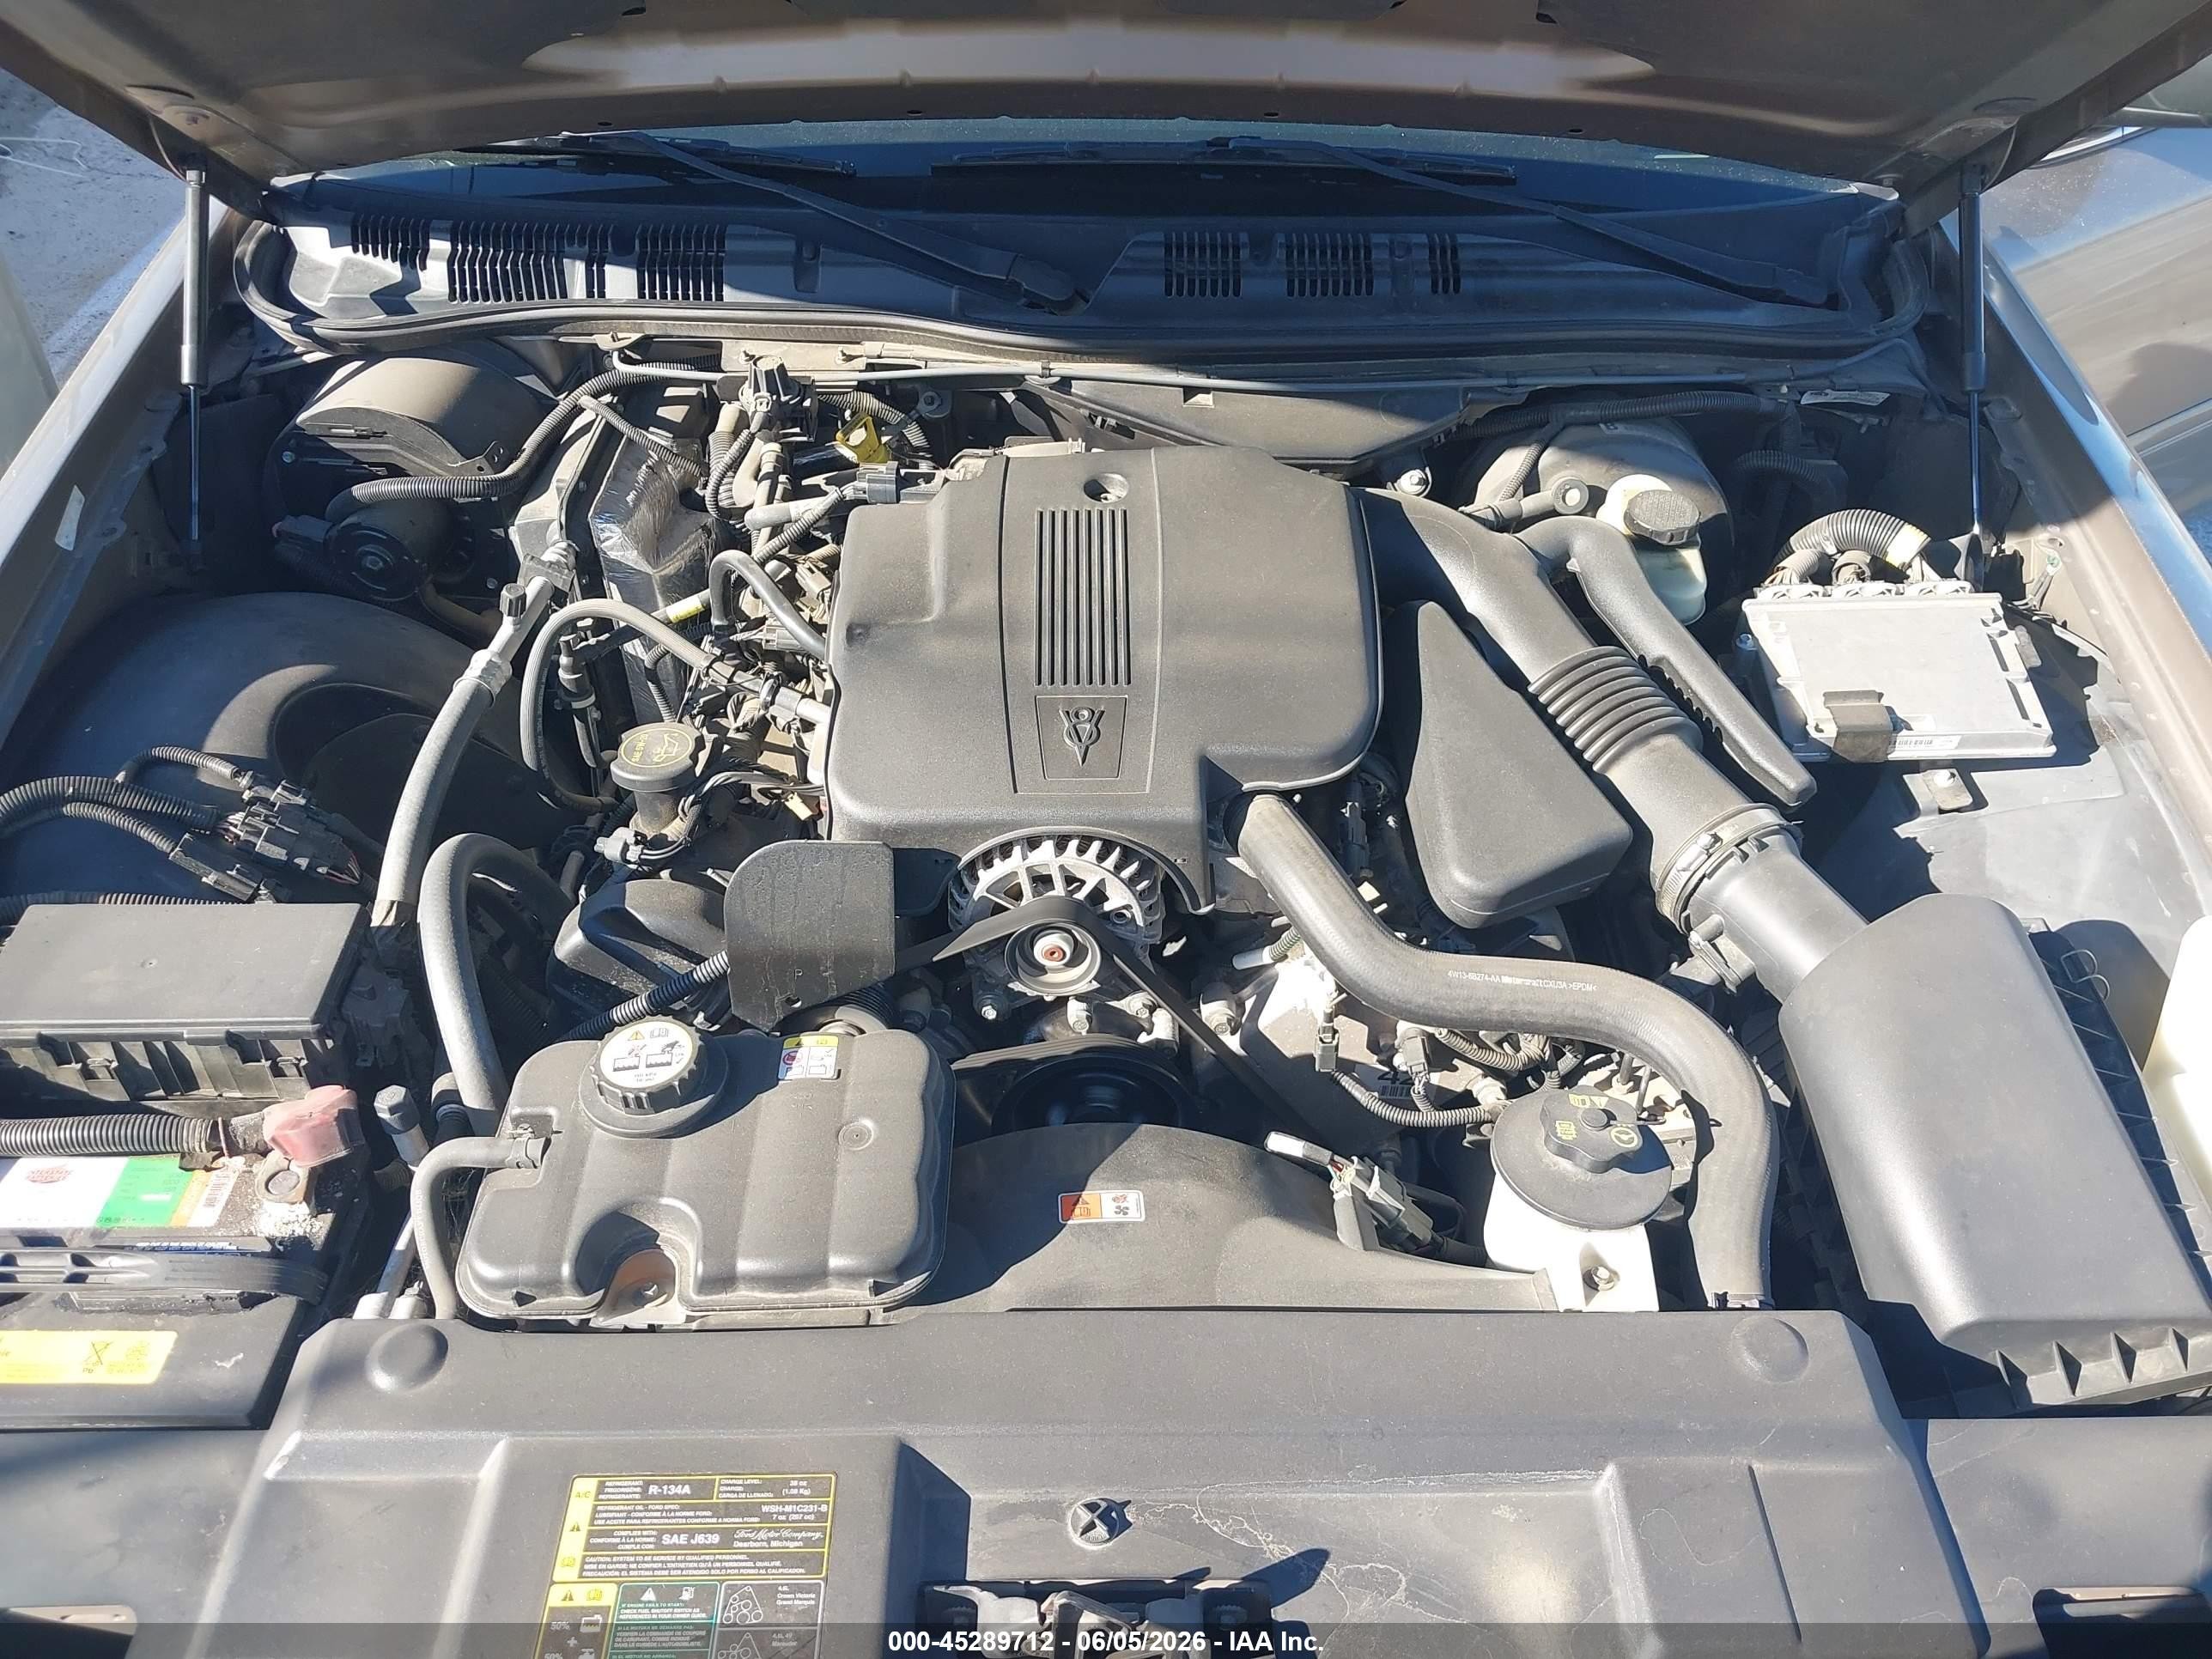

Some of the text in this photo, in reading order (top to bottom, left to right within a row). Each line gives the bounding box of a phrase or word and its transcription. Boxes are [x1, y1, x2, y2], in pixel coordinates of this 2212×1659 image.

[647, 1484, 691, 1495] R-134A
[661, 1533, 720, 1545] SAE J639
[733, 1528, 757, 1539] Ford
[733, 1540, 804, 1548] Dearborn, Michigan
[550, 1621, 570, 1631] 50%
